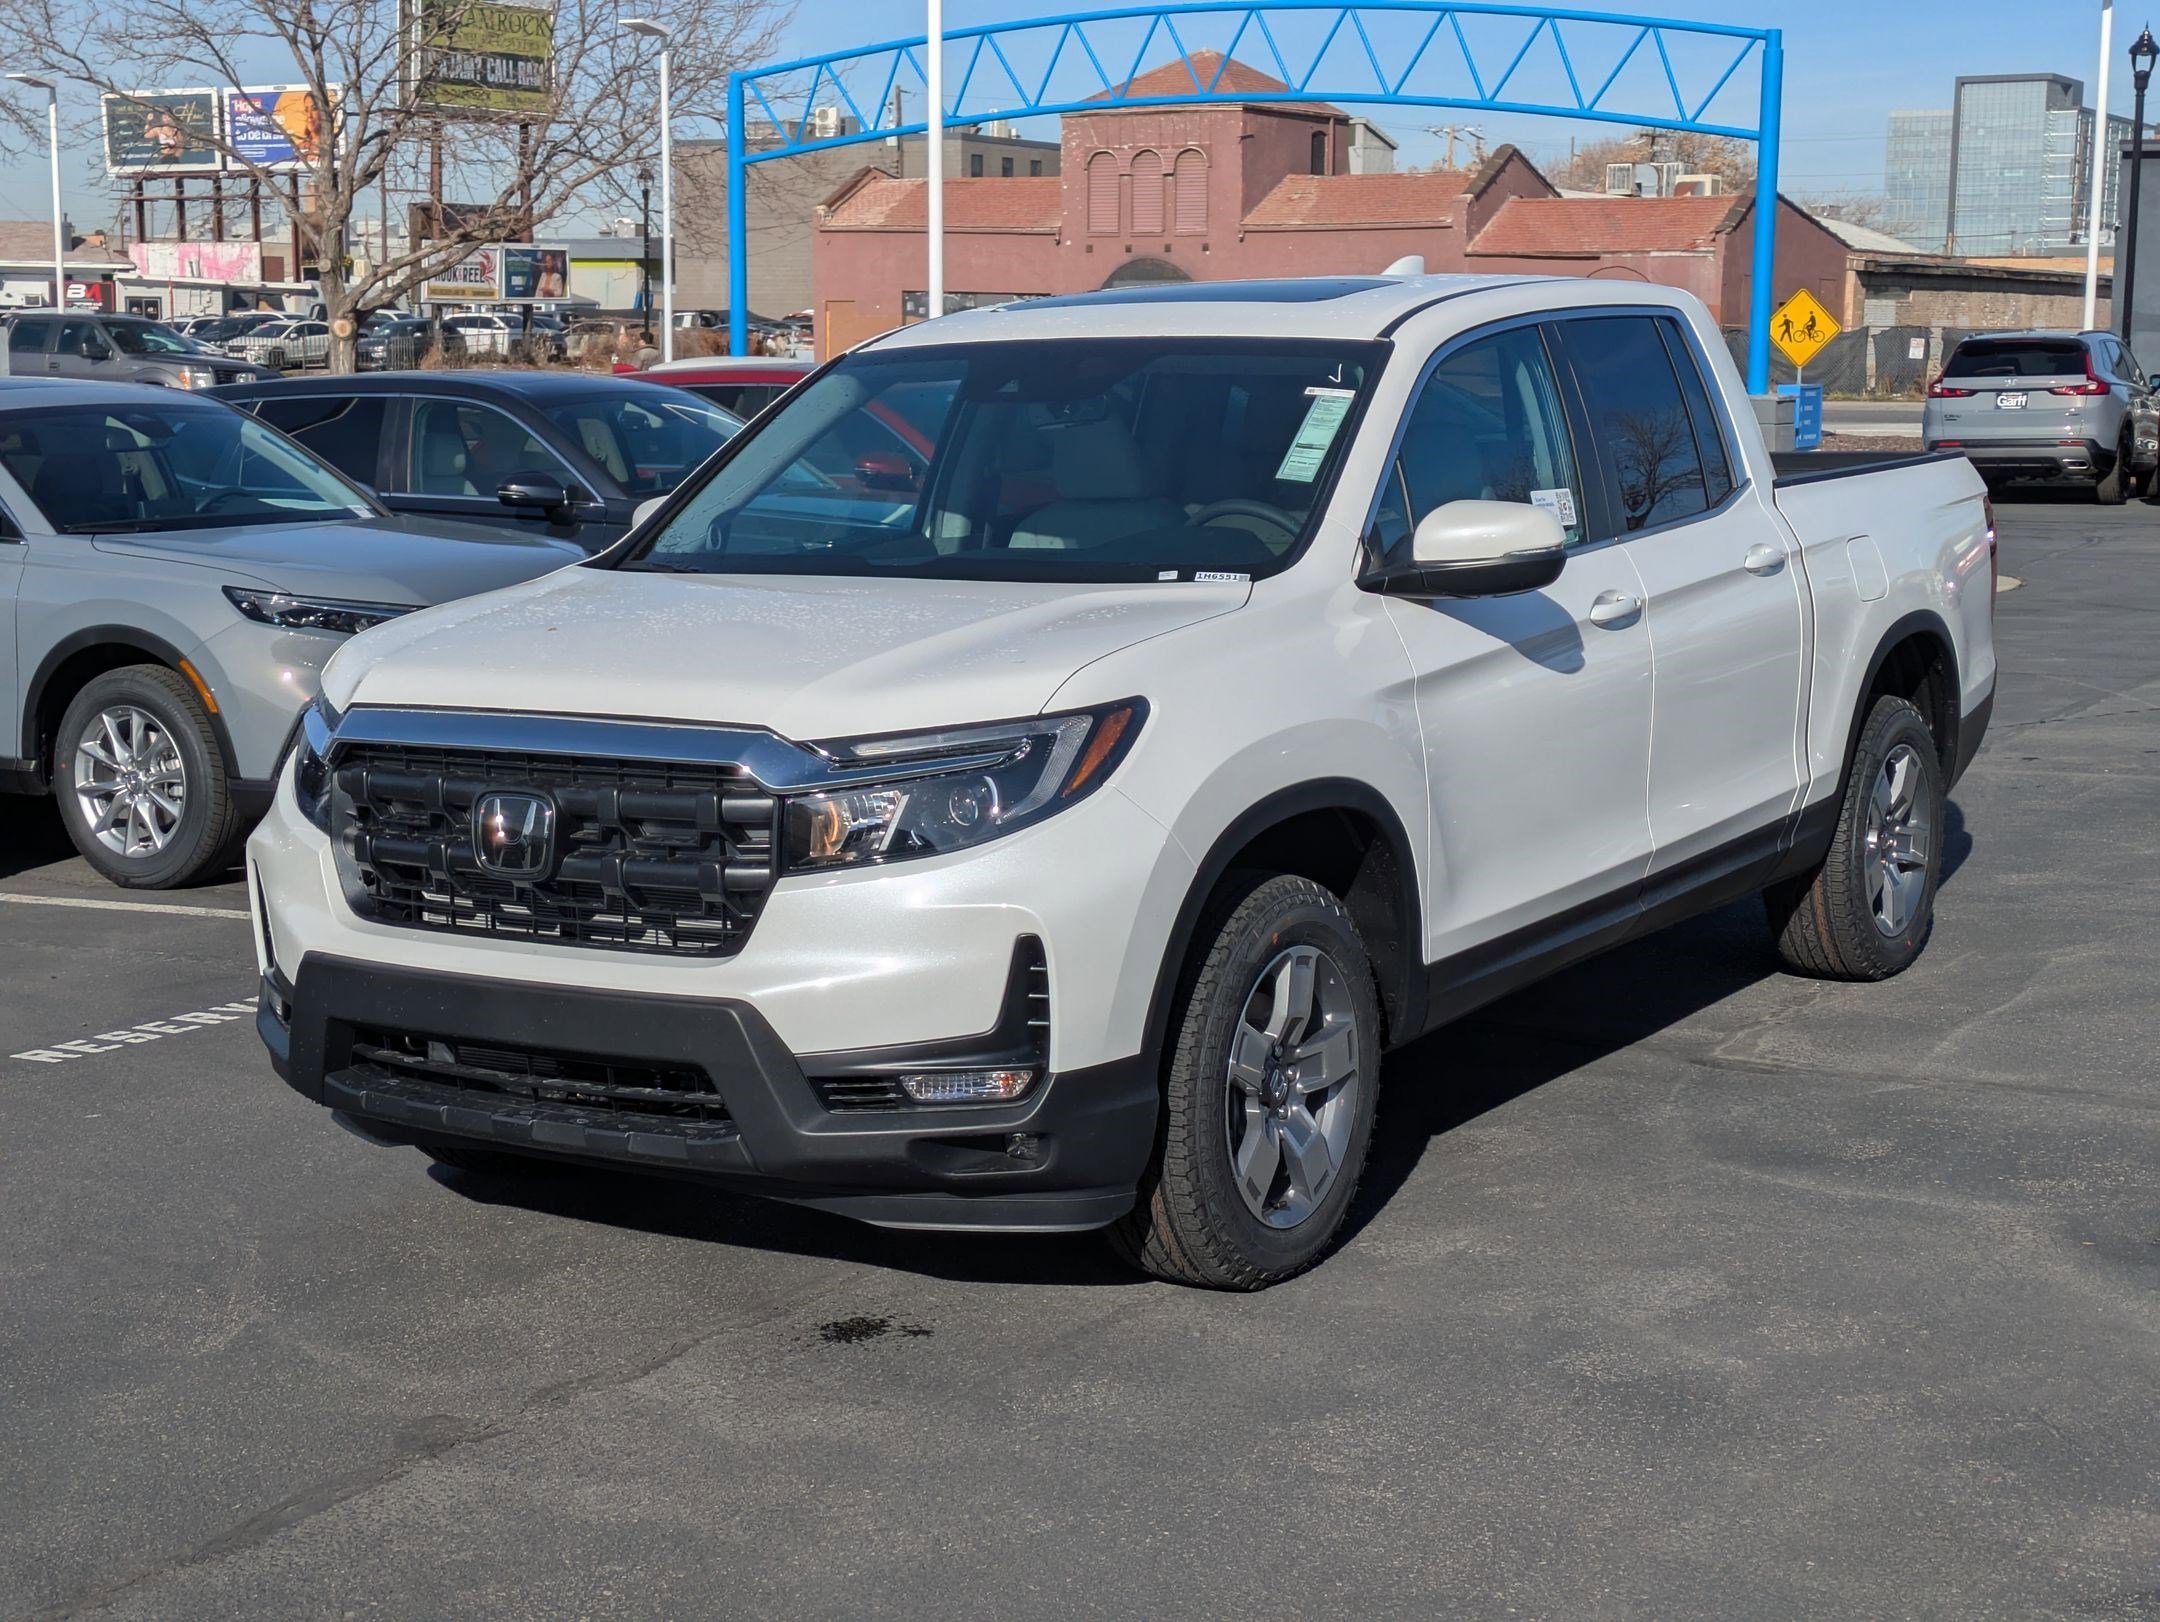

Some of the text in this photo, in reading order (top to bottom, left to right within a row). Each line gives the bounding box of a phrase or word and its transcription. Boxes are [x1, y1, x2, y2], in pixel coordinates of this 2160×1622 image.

[486, 56, 517, 84] CALL
[1997, 395, 2027, 406] Garff
[9, 995, 260, 1064] RESERV
